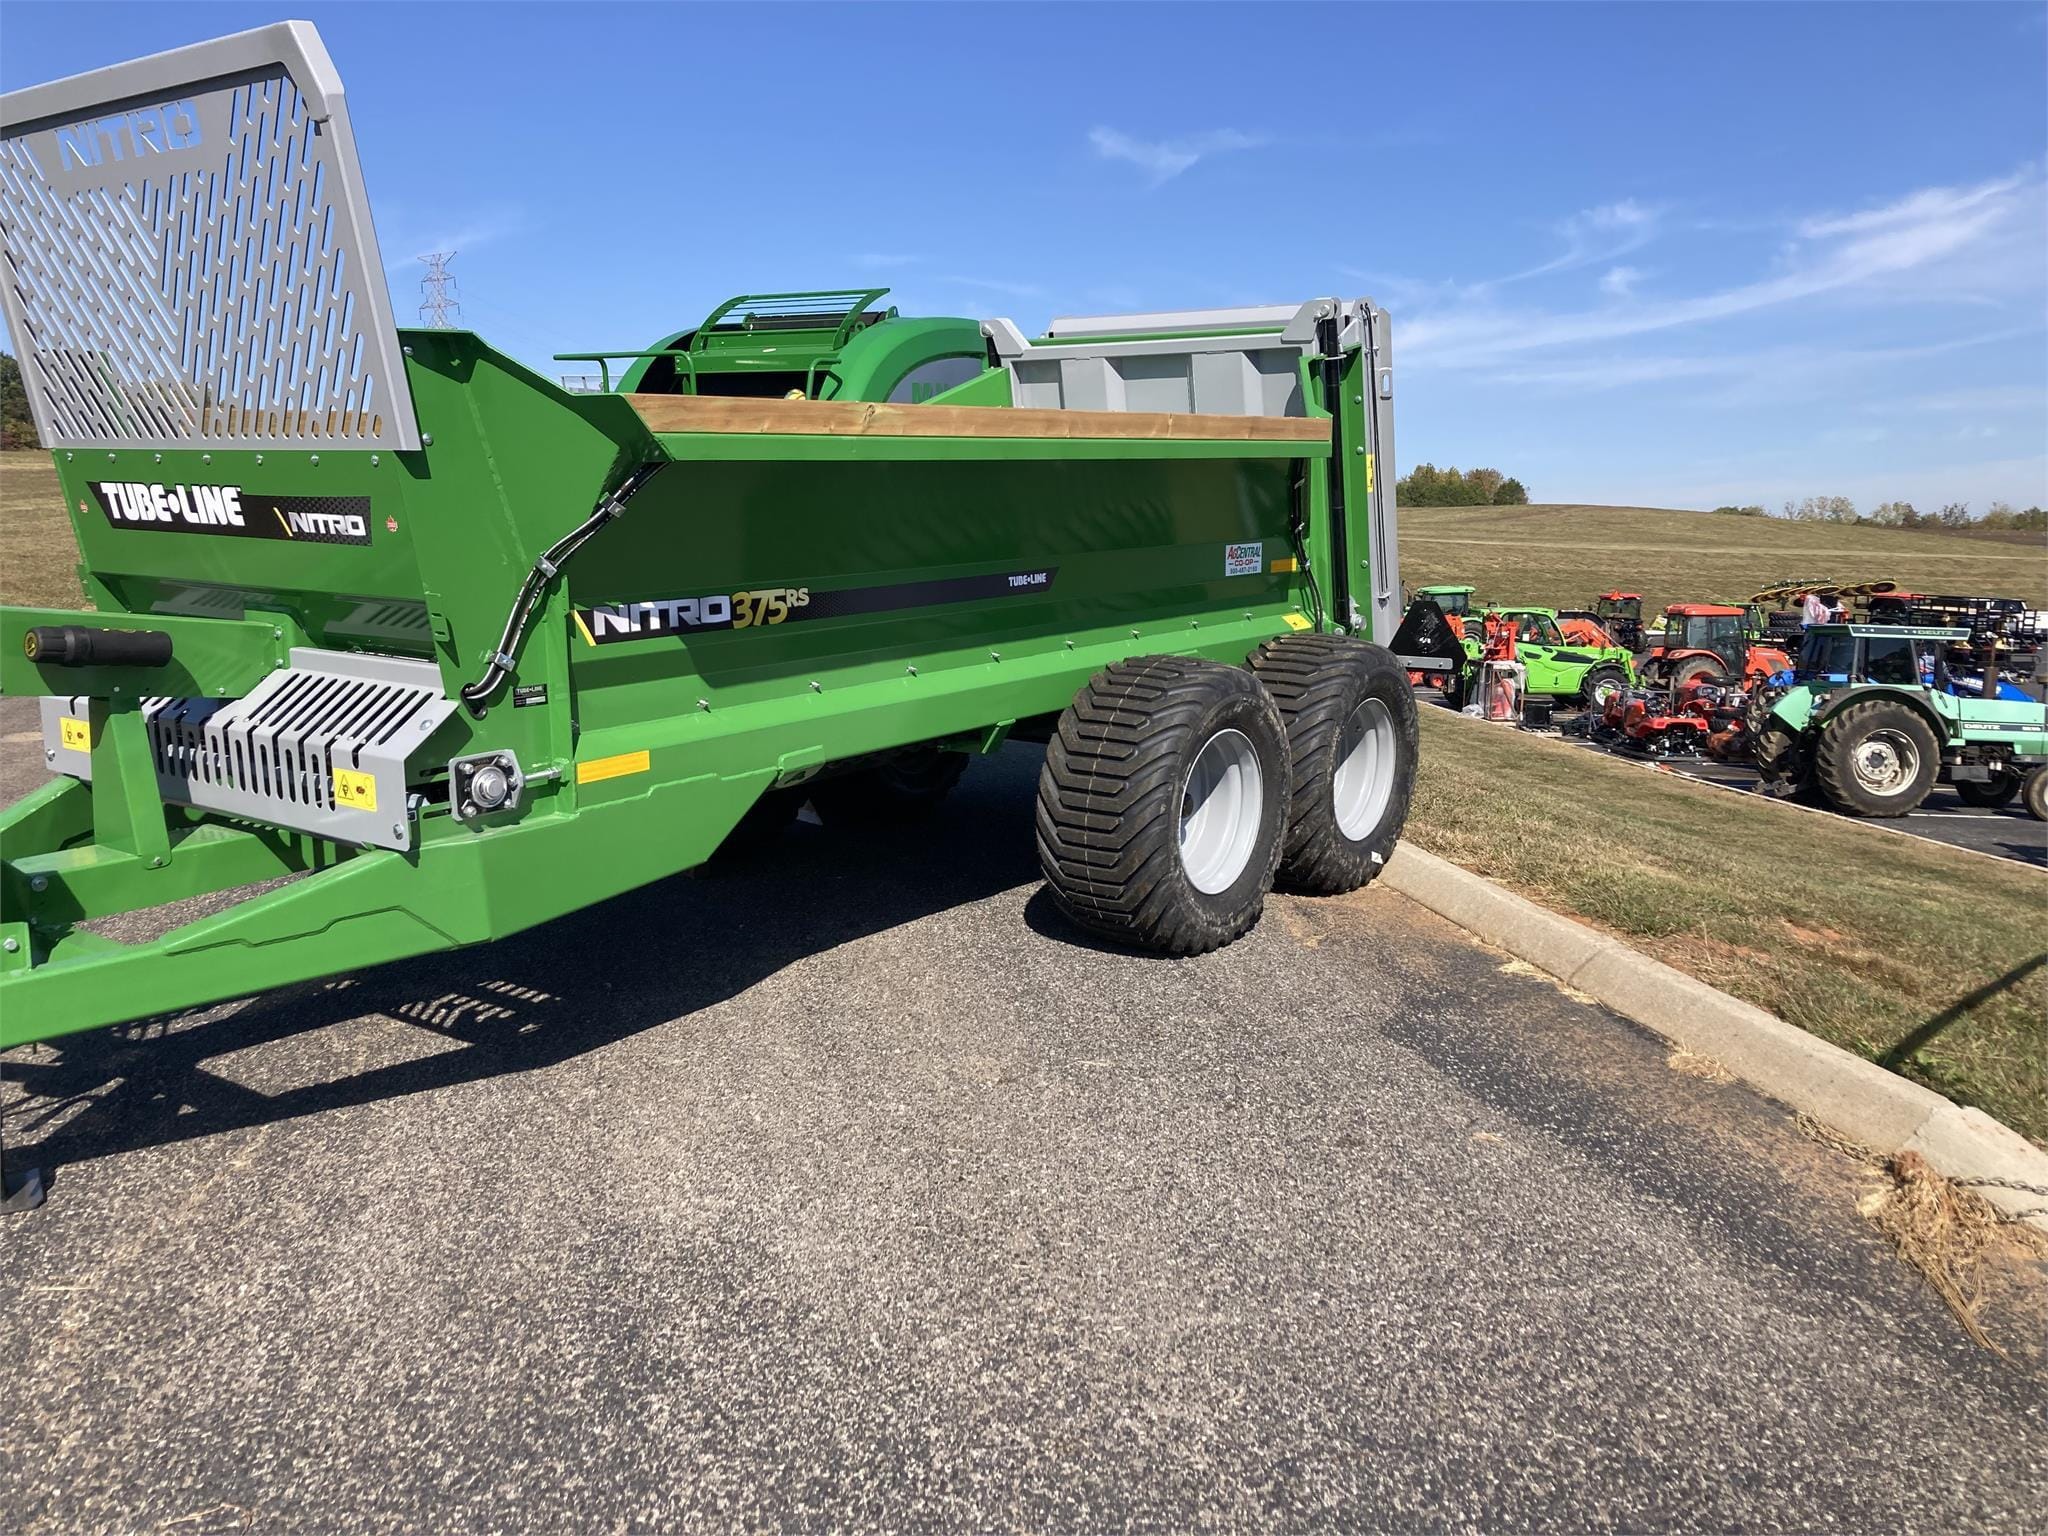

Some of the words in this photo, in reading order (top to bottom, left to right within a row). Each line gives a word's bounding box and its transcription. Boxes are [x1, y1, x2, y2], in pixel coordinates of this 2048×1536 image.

[55, 100, 200, 171] NITRO
[288, 511, 367, 537] NITRO
[1234, 559, 1254, 567] CO-OP
[593, 595, 731, 636] NITRO
[1917, 629, 1953, 637] DEUTZ
[1963, 723, 2001, 731] DEUTZ
